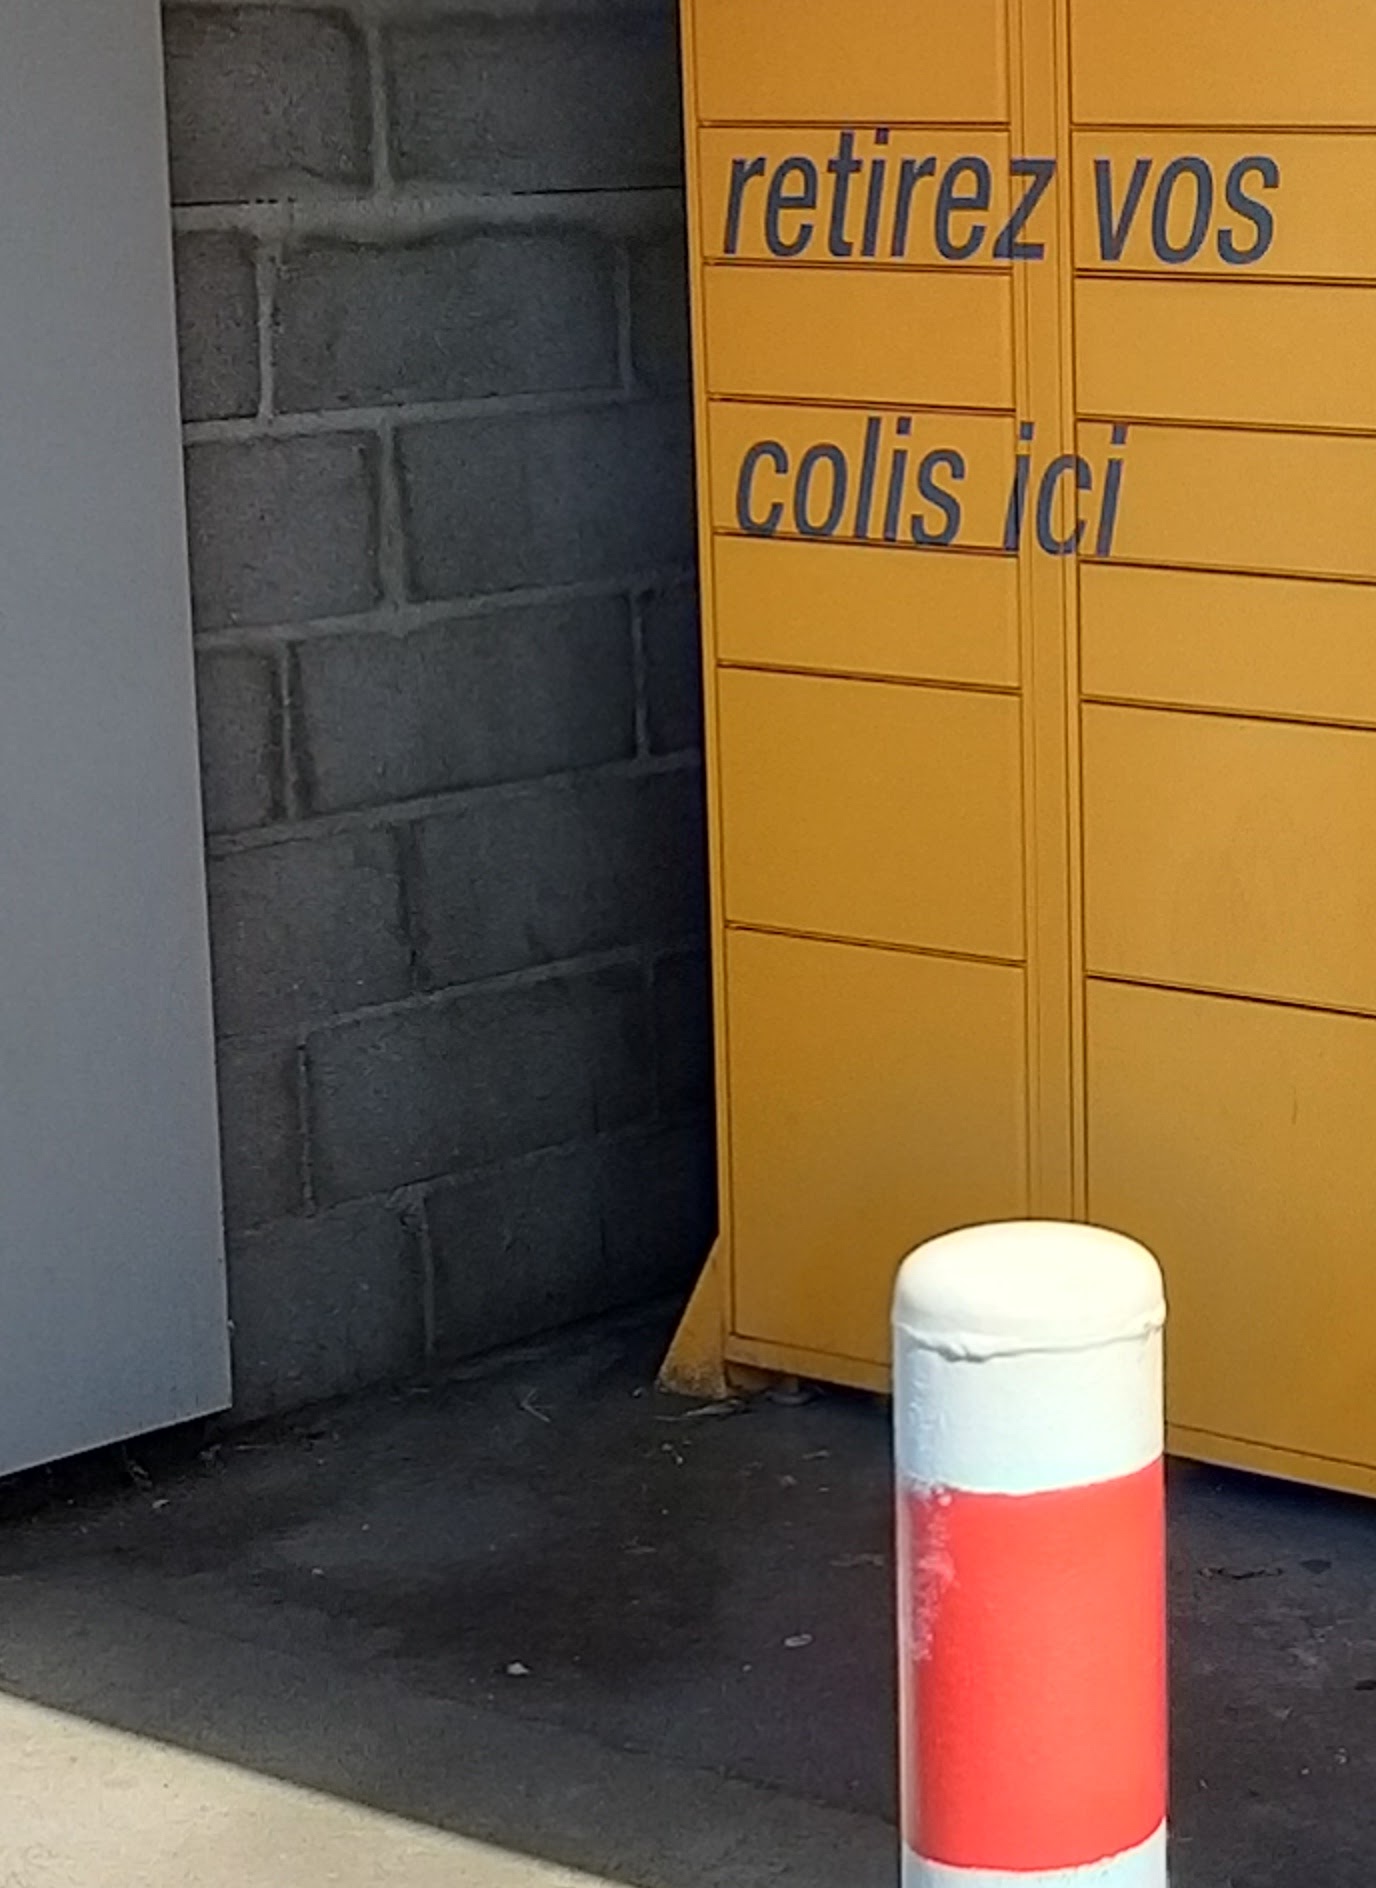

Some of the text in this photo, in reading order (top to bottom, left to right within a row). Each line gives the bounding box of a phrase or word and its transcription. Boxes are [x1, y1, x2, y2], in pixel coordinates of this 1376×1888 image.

[724, 127, 1281, 266] retirez vos
[736, 415, 1130, 559] colis ici
